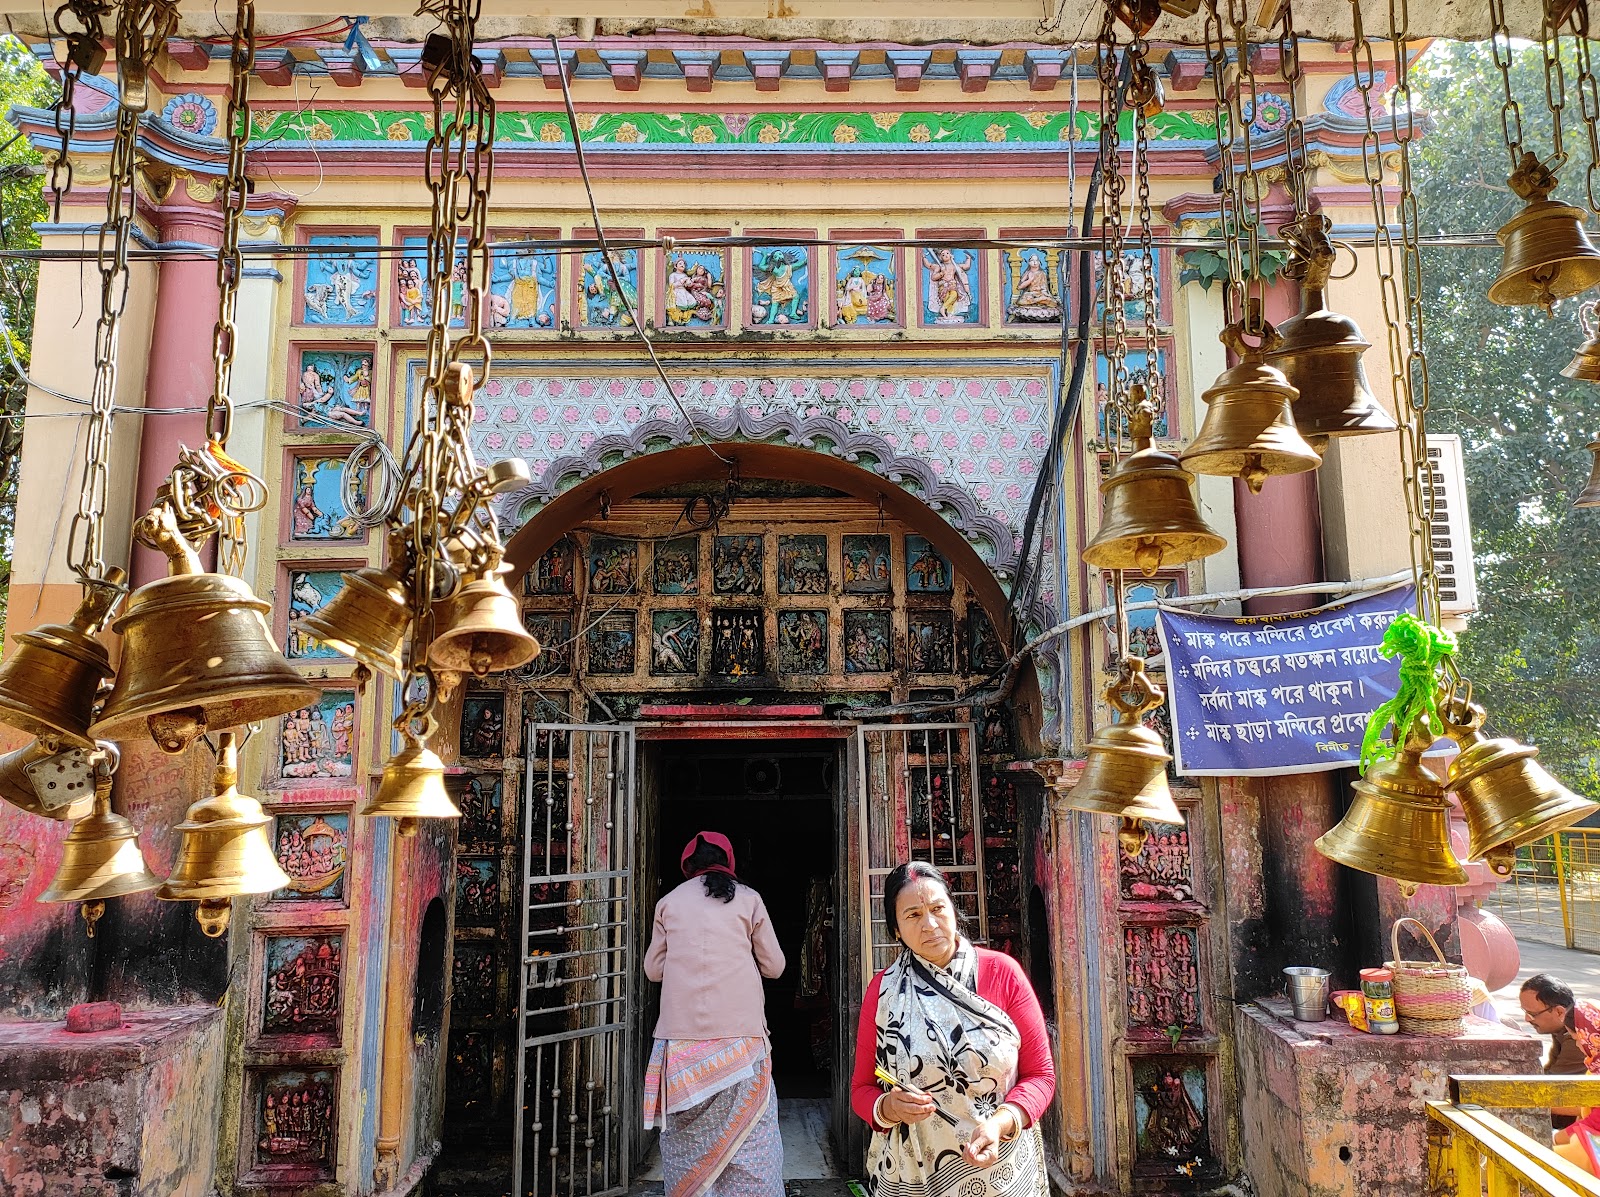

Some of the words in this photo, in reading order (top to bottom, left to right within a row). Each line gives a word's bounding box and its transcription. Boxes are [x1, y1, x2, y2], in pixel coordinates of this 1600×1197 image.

[1184, 631, 1215, 649] মাস্ক
[1219, 631, 1251, 647] পরে
[1252, 624, 1305, 645] মন্দিরে
[1309, 617, 1355, 639] প্রবেশ
[1190, 655, 1232, 681] মন্দির
[1283, 649, 1337, 671] যতক্ষন
[1198, 686, 1232, 711] সর্বদা
[1235, 687, 1267, 709] মাস্ক
[1271, 684, 1304, 705] পরে
[1308, 680, 1353, 706] থাকুন
[1204, 722, 1231, 743] মাস্ক
[1233, 718, 1272, 743] ছাড়া
[1274, 711, 1326, 739] মন্দিরে
[1315, 742, 1350, 754] বিনীত
